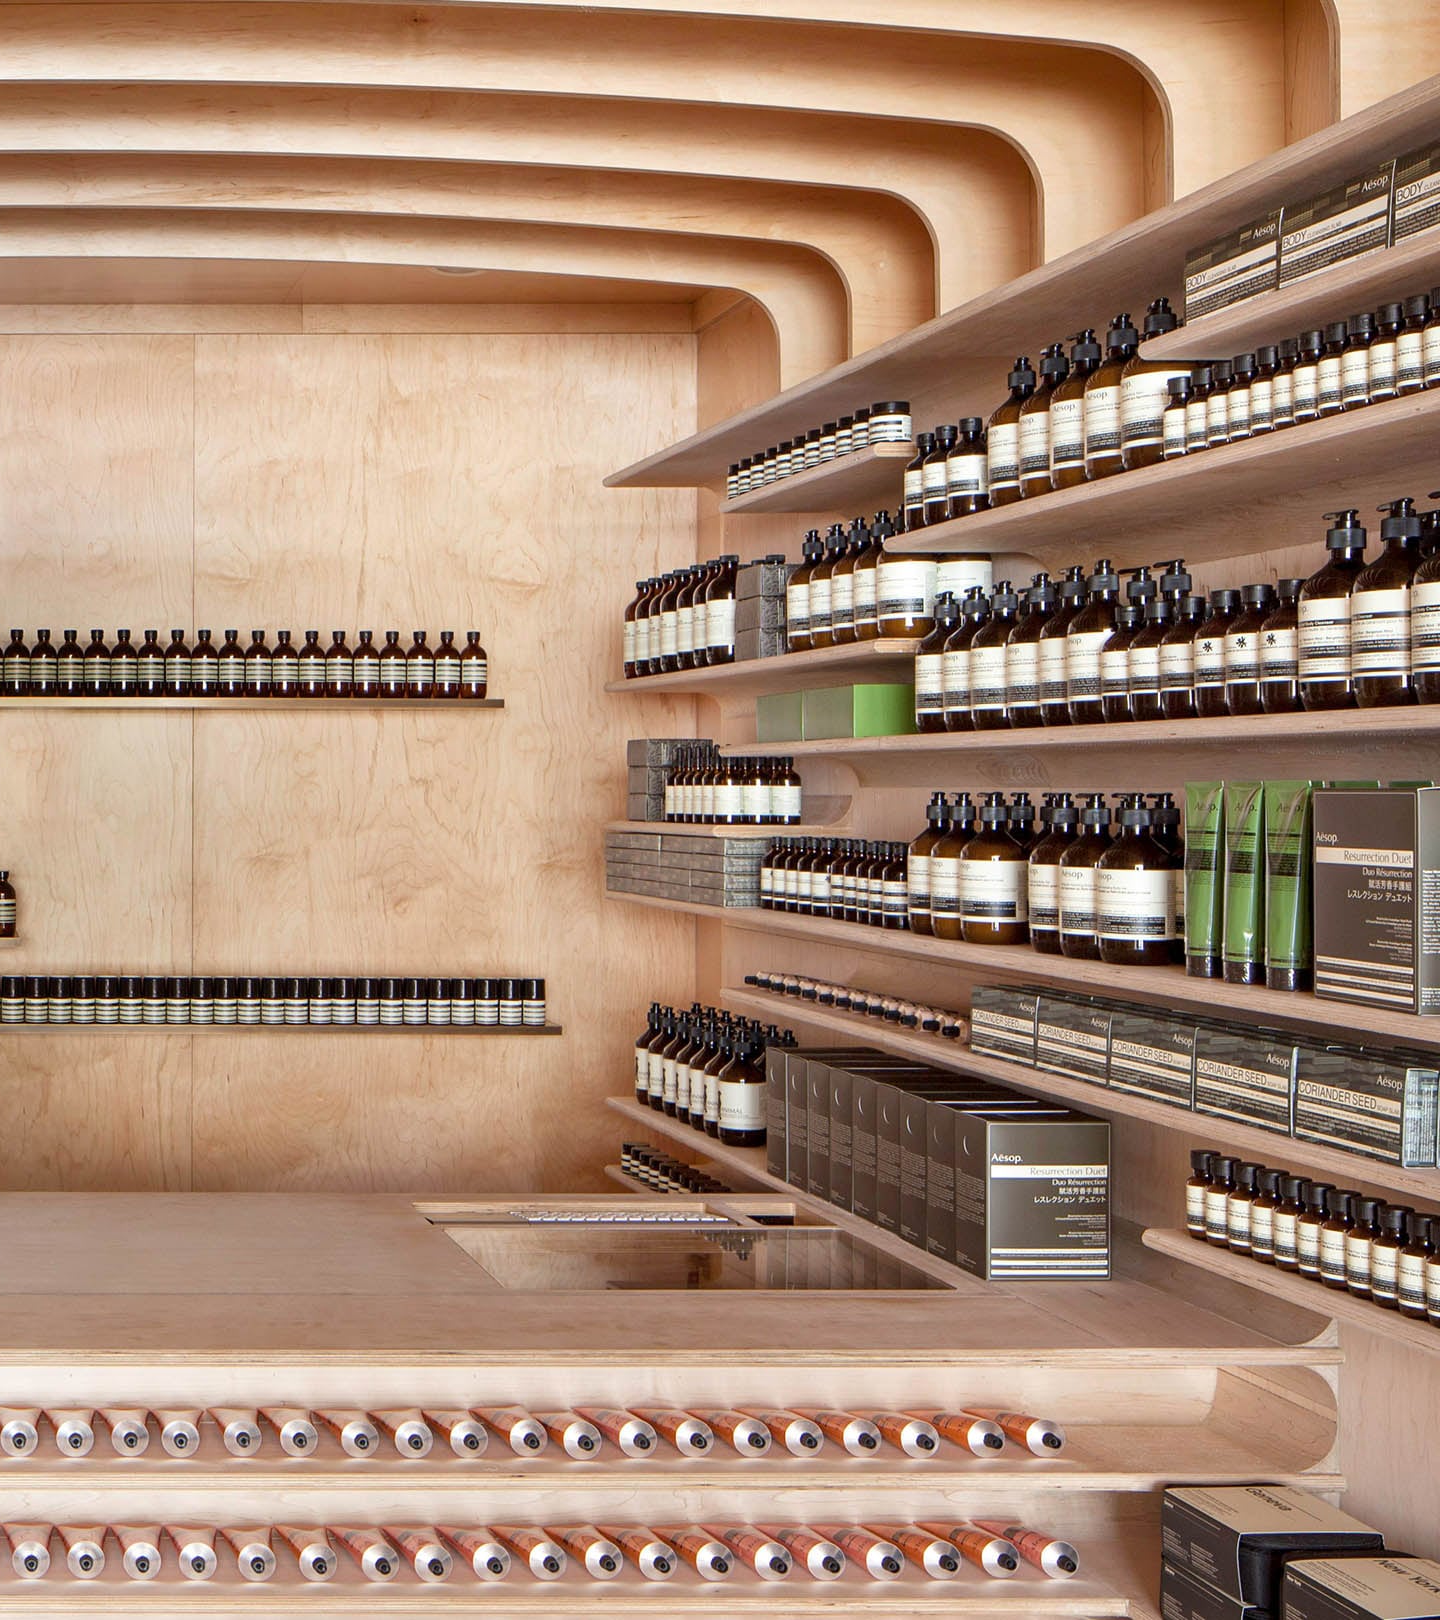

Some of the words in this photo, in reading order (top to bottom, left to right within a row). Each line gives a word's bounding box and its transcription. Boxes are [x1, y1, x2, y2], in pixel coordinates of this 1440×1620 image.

[1396, 181, 1424, 201] BODY
[1282, 230, 1306, 248] BODY
[1186, 272, 1207, 289] BODY
[1344, 850, 1390, 863] Resurrection
[1392, 852, 1412, 865] Duet
[1362, 866, 1375, 876] Duo
[972, 1010, 1004, 1024] CORIANDER
[1004, 1016, 1019, 1028] SEED
[1039, 1025, 1074, 1041] CORIANDER
[1074, 1032, 1091, 1044] SEED
[1112, 1041, 1152, 1058] CORIANDER
[1153, 1050, 1173, 1064] SEED
[1198, 1060, 1244, 1079] CORIANDER
[1244, 1070, 1267, 1086] SEED
[1299, 1081, 1351, 1103] CORIANDER
[1352, 1094, 1377, 1110] SEED
[1030, 1167, 1083, 1176] Resurrection
[1085, 1167, 1106, 1176] Duet
[1245, 1488, 1293, 1511] Geneva
